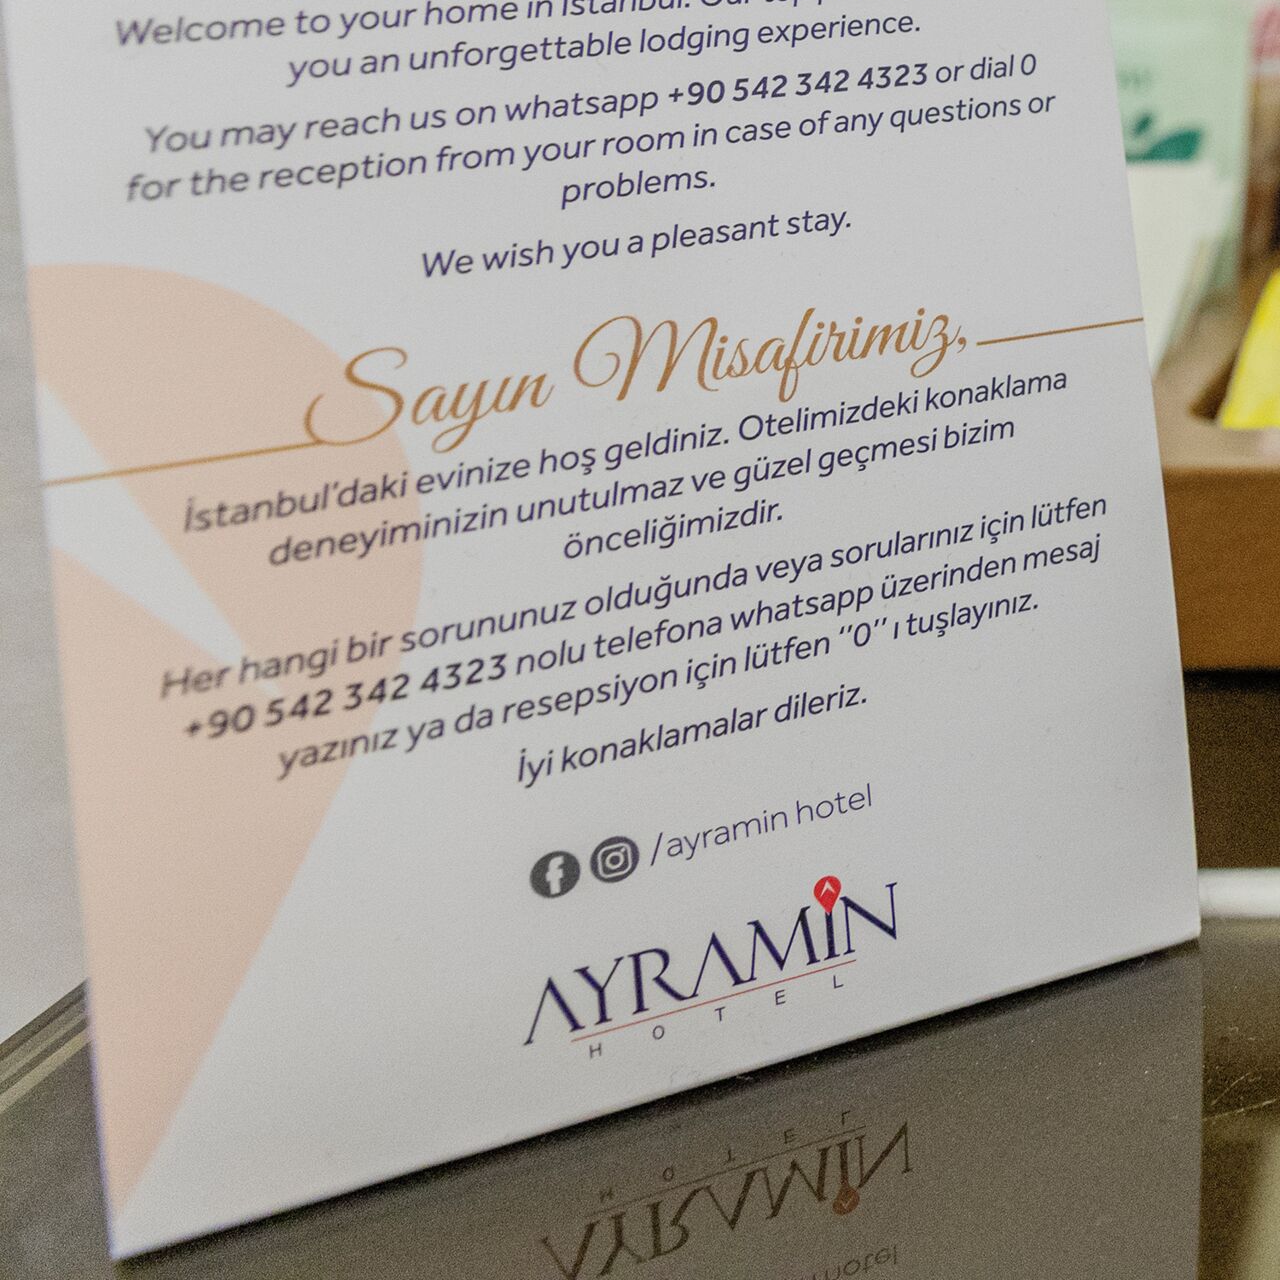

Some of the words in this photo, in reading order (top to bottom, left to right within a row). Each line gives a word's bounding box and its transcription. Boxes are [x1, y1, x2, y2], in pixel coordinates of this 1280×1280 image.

[116, 17, 285, 46] Welcome
[295, 11, 331, 35] to
[338, 8, 417, 39] your
[424, 0, 519, 26] home
[287, 58, 352, 88] you
[360, 53, 400, 75] an
[409, 31, 632, 71] unforgettable
[639, 24, 750, 56] lodging
[757, 14, 920, 48] experience.
[128, 174, 181, 201] for
[191, 169, 250, 196] the
[259, 153, 427, 189] reception
[436, 145, 515, 172] from
[522, 139, 596, 171] your
[602, 131, 685, 156] room
[693, 123, 718, 147] in
[725, 120, 792, 144] case
[798, 109, 831, 137] of
[834, 112, 884, 137] any
[890, 97, 1021, 133] questions
[1028, 95, 1056, 114] or
[146, 127, 211, 152] You
[221, 123, 297, 150] may
[305, 107, 401, 139] reach
[410, 109, 447, 130] us
[455, 105, 496, 126] on
[505, 91, 659, 121] whatsapp
[668, 80, 725, 106] +90
[732, 74, 788, 102] 542
[795, 69, 850, 96] 342
[857, 63, 928, 90] 4323
[935, 65, 965, 84] or
[970, 54, 1015, 81] dial
[1020, 53, 1037, 76] 0
[561, 170, 715, 210] problems.
[422, 249, 474, 278] We
[482, 239, 554, 271] wish
[561, 238, 620, 270] you
[627, 235, 644, 254] a
[651, 214, 779, 258] pleasant
[786, 210, 851, 237] stay.
[304, 347, 553, 453] Sayın
[573, 307, 967, 403] Misafirimiz,
[416, 457, 531, 494] evinize
[539, 448, 596, 476] hoş
[604, 423, 729, 471] geldiniz.
[738, 390, 919, 441] Otelimizdeki
[925, 372, 1067, 411] konaklama
[269, 504, 508, 566] deneyiminizin
[516, 477, 684, 523] unutulmaz
[691, 470, 726, 492] ve
[733, 448, 812, 493] güzel
[818, 427, 937, 478] geçmesi
[944, 419, 1015, 449] bizim
[563, 499, 782, 559] önceliğimizdir.
[161, 667, 230, 698] Her
[239, 640, 338, 683] hangi
[347, 632, 393, 663] bir
[401, 600, 577, 652] sorununuz
[584, 563, 748, 616] olduğunda
[755, 553, 823, 584] veya
[830, 523, 974, 568] sorularınız
[980, 511, 1025, 544] için
[1031, 497, 1107, 529] lütfen
[186, 704, 256, 739] +90
[265, 688, 333, 727] 542
[344, 673, 410, 711] 342
[420, 653, 507, 693] 4323
[516, 640, 586, 675] nolu
[594, 616, 723, 659] telefona
[730, 585, 874, 631] whatsapp
[881, 556, 1016, 600] üzerinden
[1023, 533, 1100, 571] mesaj
[279, 728, 399, 780] yazınız
[406, 718, 445, 753] ya
[454, 704, 494, 734] da
[502, 669, 678, 724] resepsiyon
[686, 653, 737, 690] için
[744, 635, 830, 672] lütfen
[906, 593, 1038, 638] tuşlayınız.
[518, 748, 554, 789] İyi
[561, 707, 768, 772] konaklamalar
[774, 684, 867, 723] dileriz.
[796, 783, 872, 824] hotel
[589, 974, 844, 1058] HOTEL
